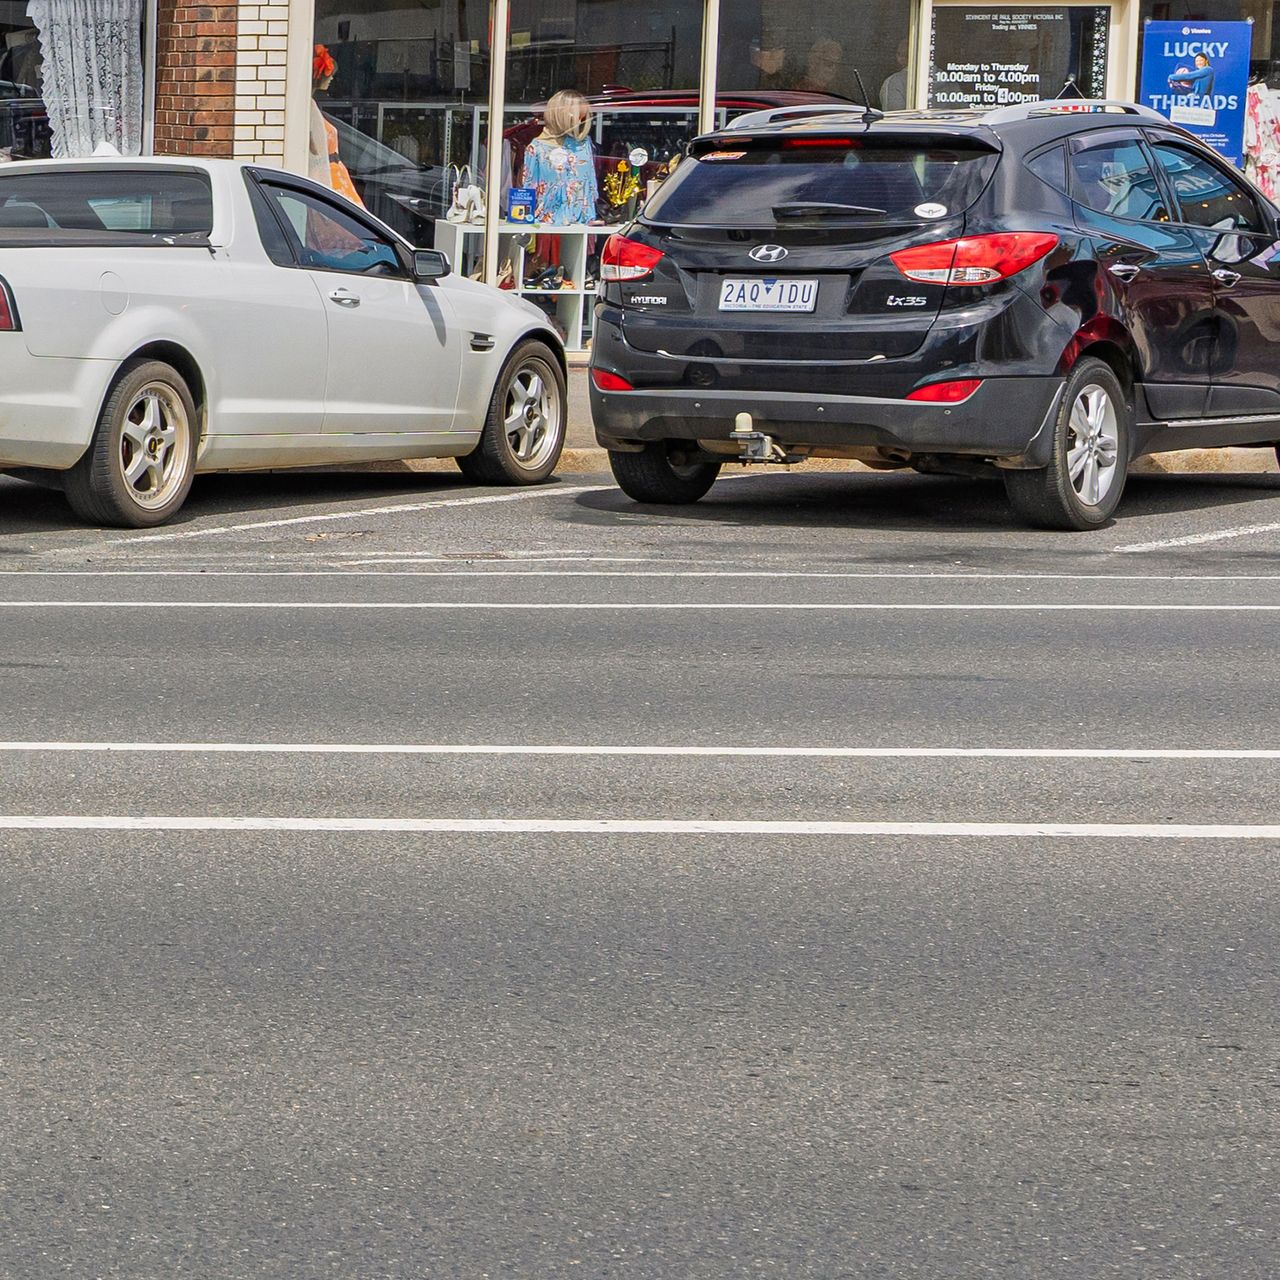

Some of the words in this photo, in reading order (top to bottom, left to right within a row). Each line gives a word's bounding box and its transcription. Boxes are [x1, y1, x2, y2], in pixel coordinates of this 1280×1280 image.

[1163, 41, 1229, 58] LUCKY
[946, 63, 979, 73] Monday
[980, 63, 990, 71] to
[991, 63, 1029, 73] Thursday
[935, 72, 981, 83] 10.00am
[983, 72, 996, 83] to
[997, 72, 1040, 84] 4.00pm
[974, 83, 1000, 92] Friday
[935, 92, 981, 103] 10.00am
[983, 92, 996, 103] to
[1148, 94, 1239, 111] THREADS
[630, 295, 668, 305] HYUNDAI
[886, 295, 927, 306] ix35
